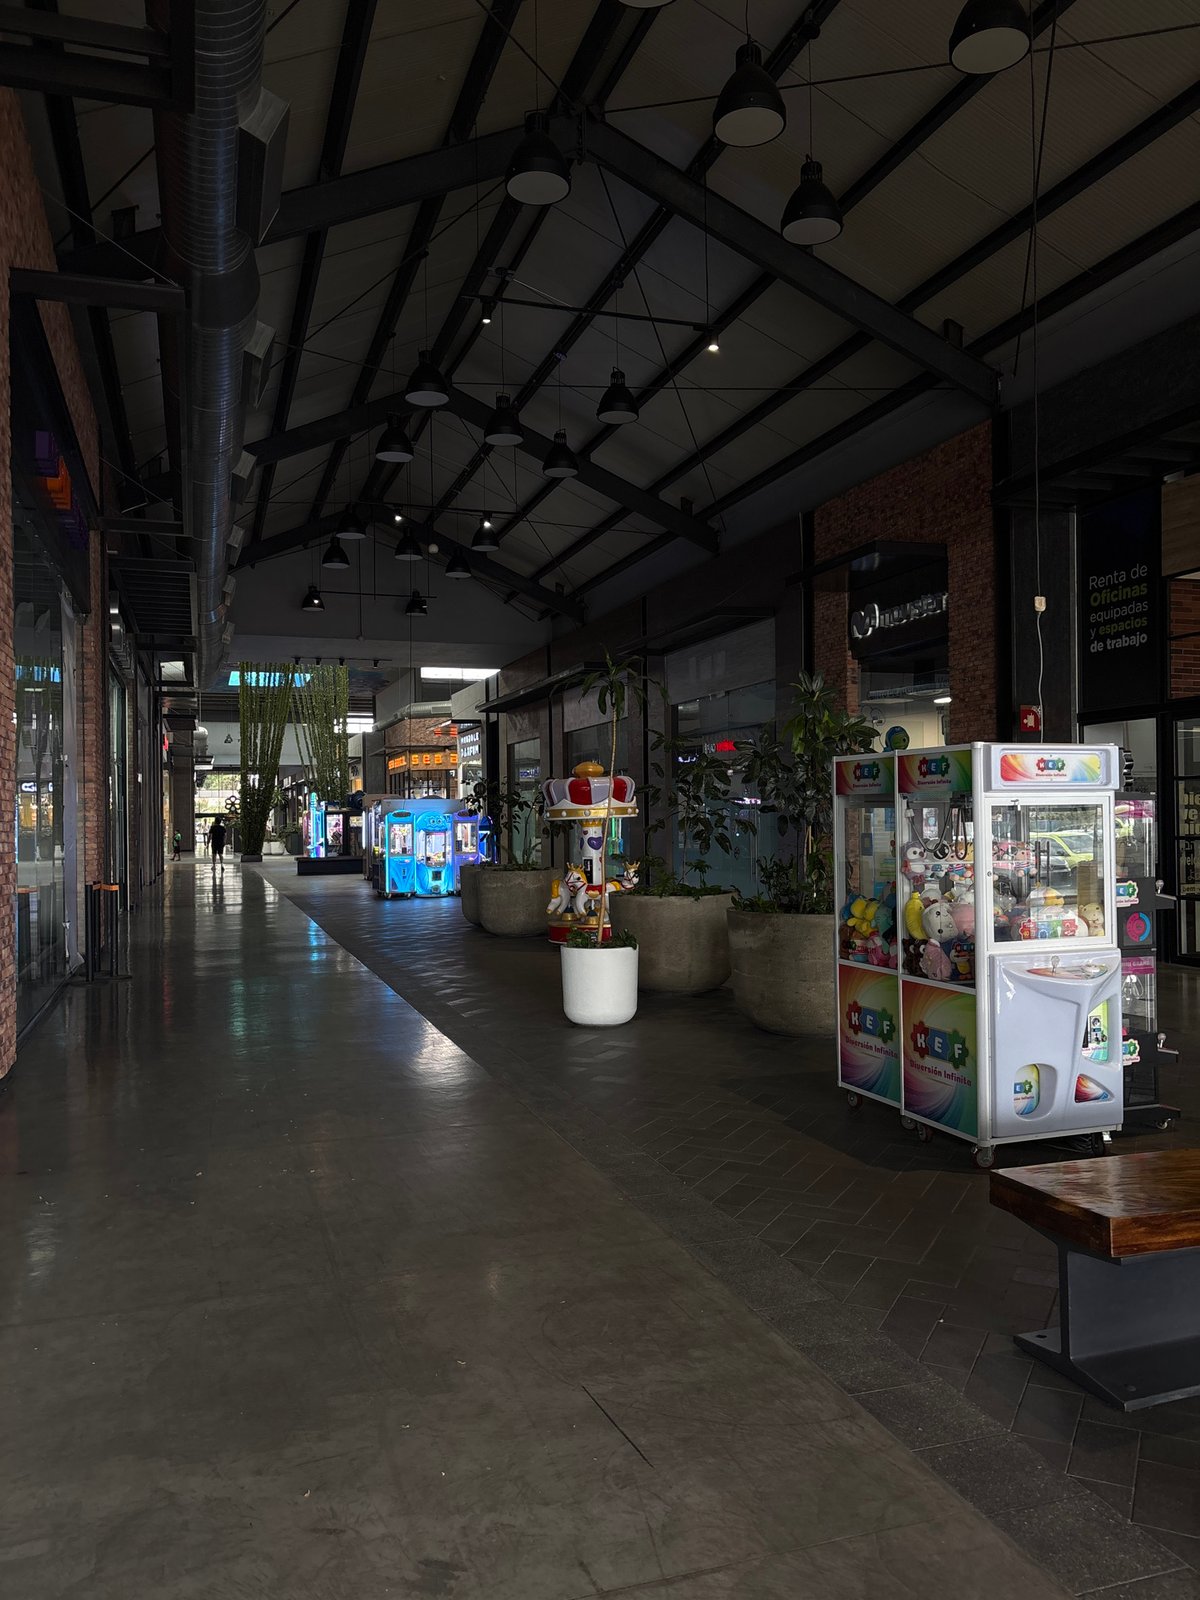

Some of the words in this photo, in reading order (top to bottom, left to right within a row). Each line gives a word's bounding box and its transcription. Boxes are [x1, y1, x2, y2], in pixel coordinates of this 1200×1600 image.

[1089, 569, 1127, 590] Renta
[1130, 562, 1149, 579] de
[1089, 582, 1149, 607] Oficinas
[1090, 600, 1149, 623] equipadas
[1089, 627, 1096, 639] y
[1098, 616, 1149, 635] espacios
[1090, 640, 1105, 653] de
[1106, 631, 1149, 650] trabajo
[851, 1012, 890, 1034] KEF
[845, 1036, 873, 1050] Diversión
[874, 1045, 898, 1058] Infinita
[916, 1033, 962, 1058] KEF
[909, 1059, 943, 1077] Diversión
[944, 1070, 972, 1086] Infinita
